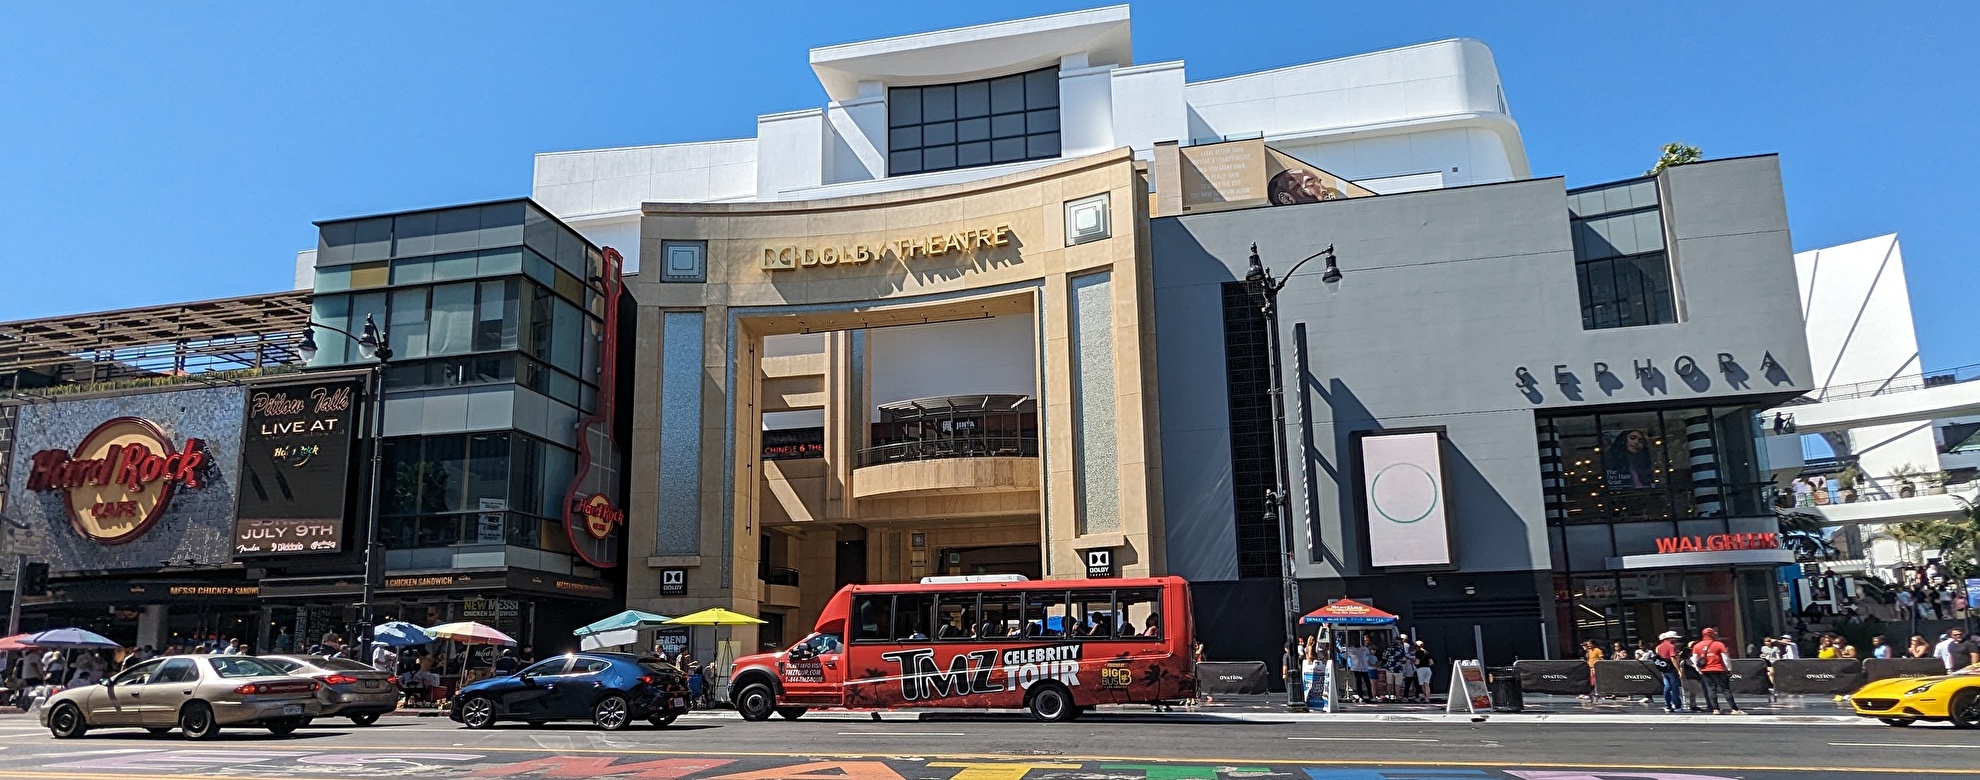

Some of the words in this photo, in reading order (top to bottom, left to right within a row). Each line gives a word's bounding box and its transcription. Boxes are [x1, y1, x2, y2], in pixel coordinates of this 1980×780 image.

[801, 240, 887, 268] DOLBY
[891, 224, 1010, 259] THEATRE
[1514, 350, 1783, 389] SEPHORA
[251, 392, 304, 418] Pillow
[311, 387, 350, 413] Talk
[262, 421, 305, 435] LIVE
[310, 418, 338, 431] AT
[764, 445, 797, 454] CHINESE
[799, 444, 806, 452] 6
[26, 444, 123, 492] Hard
[115, 437, 204, 492] Rock
[580, 498, 603, 517] Hard
[602, 504, 624, 526] Rock
[242, 527, 288, 539] JULY
[295, 525, 333, 536] 9TH
[1655, 532, 1779, 555] WALGREENS
[170, 587, 196, 595] MESSI
[389, 578, 417, 587] CHICKEN
[418, 576, 452, 586] SANDWICH
[464, 599, 487, 610] NEW
[488, 599, 519, 610] MESSI
[659, 635, 687, 644] TREND
[662, 644, 684, 653] HER
[1004, 644, 1081, 665] CELEBRITY
[881, 648, 1004, 700] TMZ
[1004, 660, 1081, 691] TOUR
[1102, 668, 1118, 677] BIG
